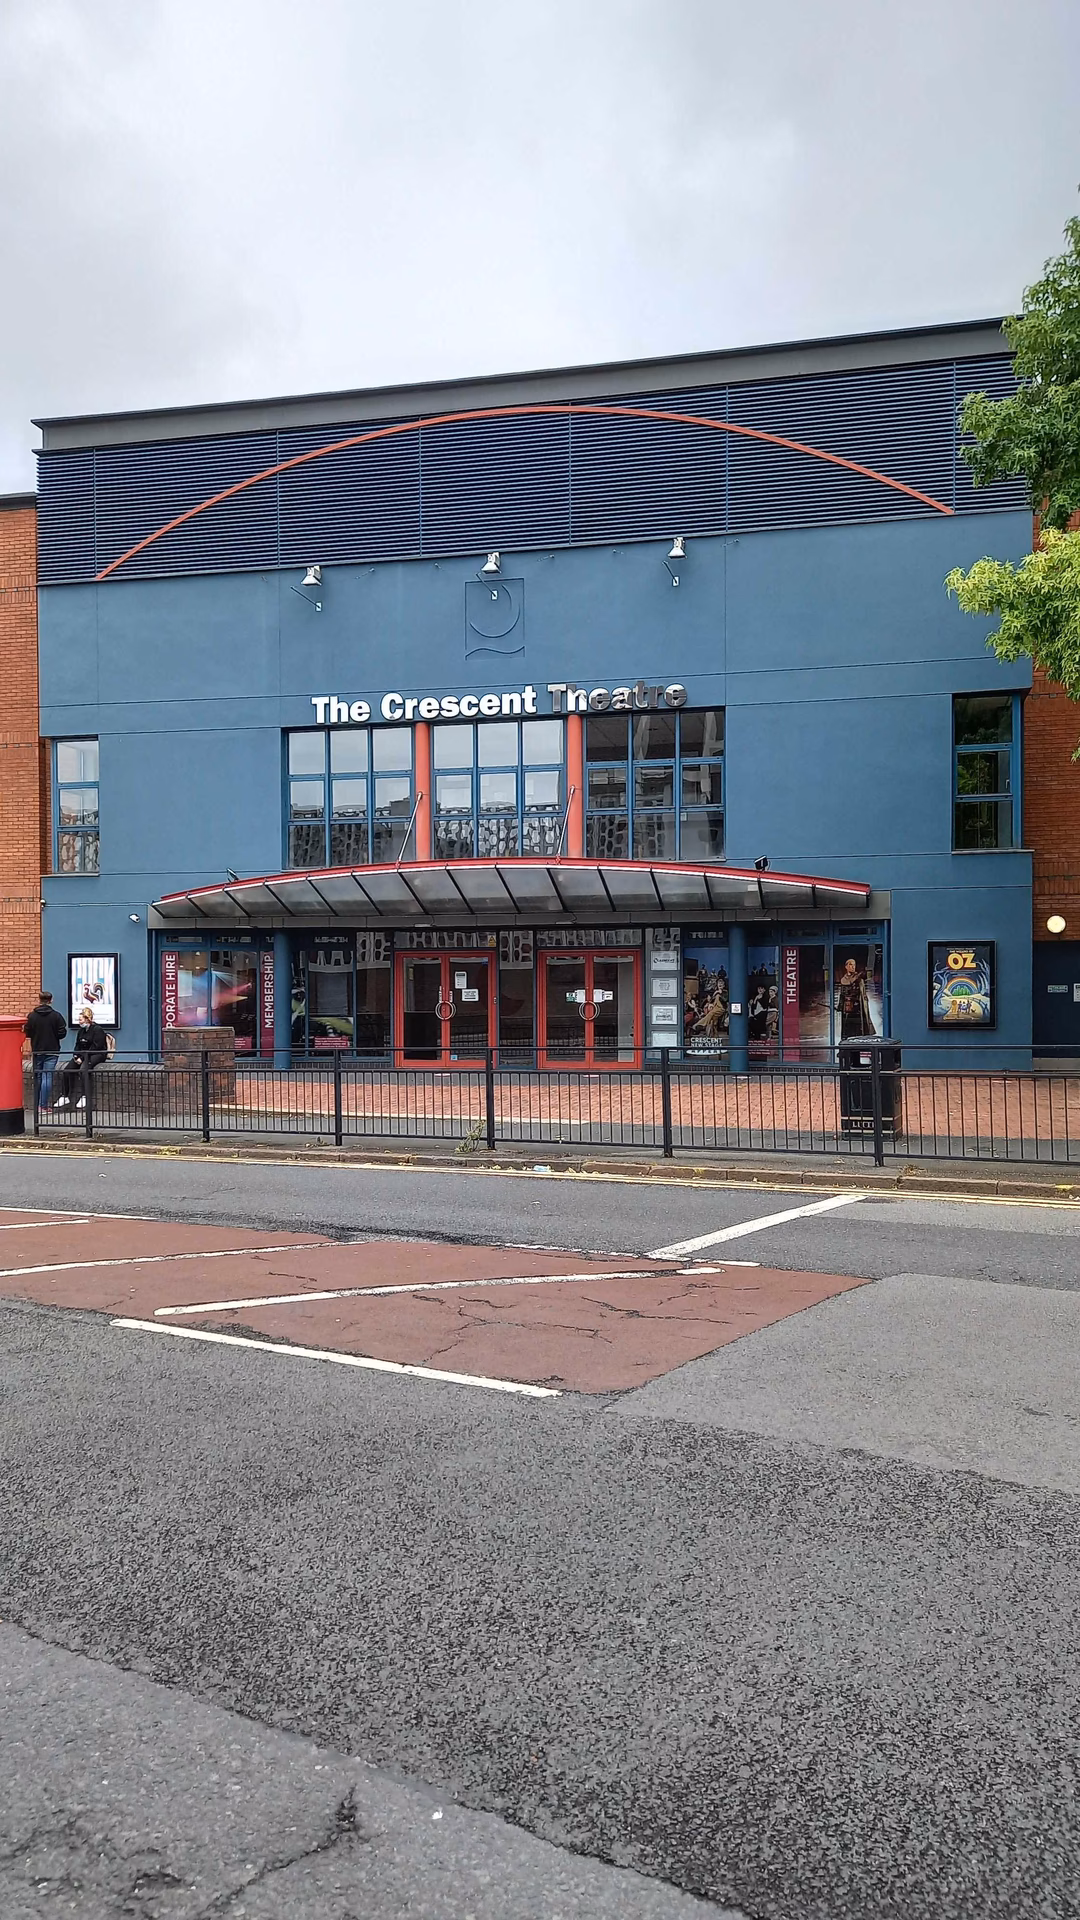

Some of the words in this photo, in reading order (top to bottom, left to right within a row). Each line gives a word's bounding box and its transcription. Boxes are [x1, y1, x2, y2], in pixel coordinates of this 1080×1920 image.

[311, 696, 371, 724] The
[380, 685, 537, 721] Crescent
[547, 680, 688, 713] Theatre
[166, 954, 176, 980] HIRE
[786, 949, 797, 1005] THEATRE
[947, 953, 977, 970] OZ
[264, 955, 274, 1028] MEMBERSHIP
